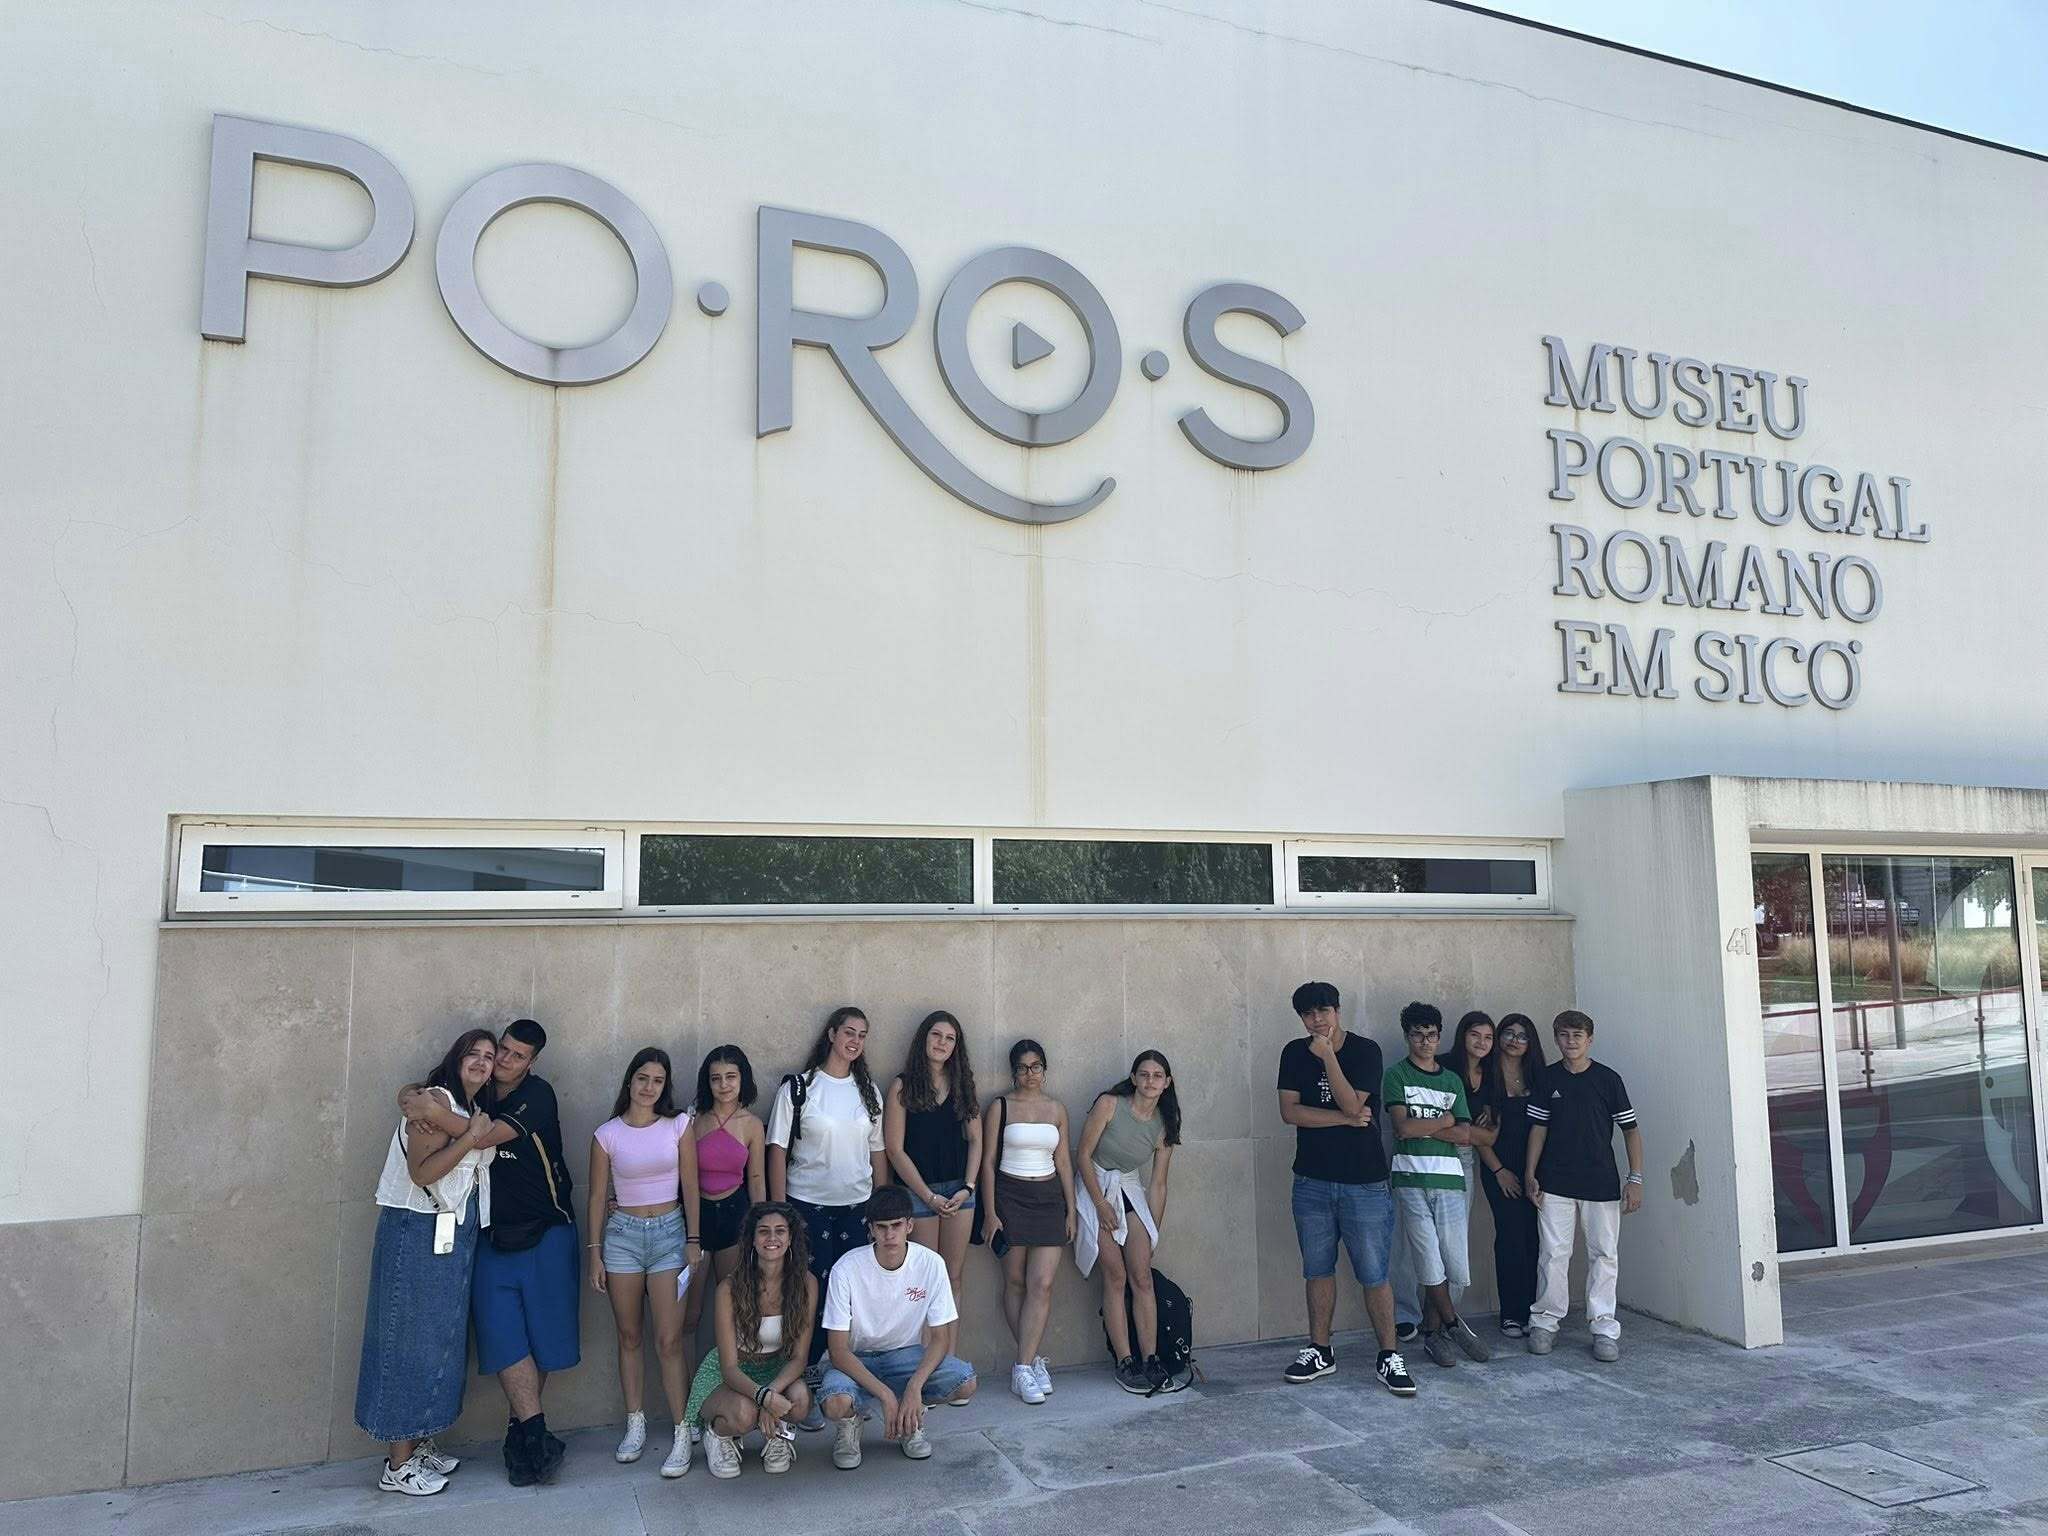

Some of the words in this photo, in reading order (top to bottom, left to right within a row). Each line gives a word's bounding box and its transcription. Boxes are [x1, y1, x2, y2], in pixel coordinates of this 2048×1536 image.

[1541, 335, 1809, 440] MUSEU
[1546, 429, 1931, 543] PORTUGAL
[1550, 523, 1884, 624] ROMANO
[1554, 620, 1679, 699] EM
[1726, 927, 1751, 956] 41
